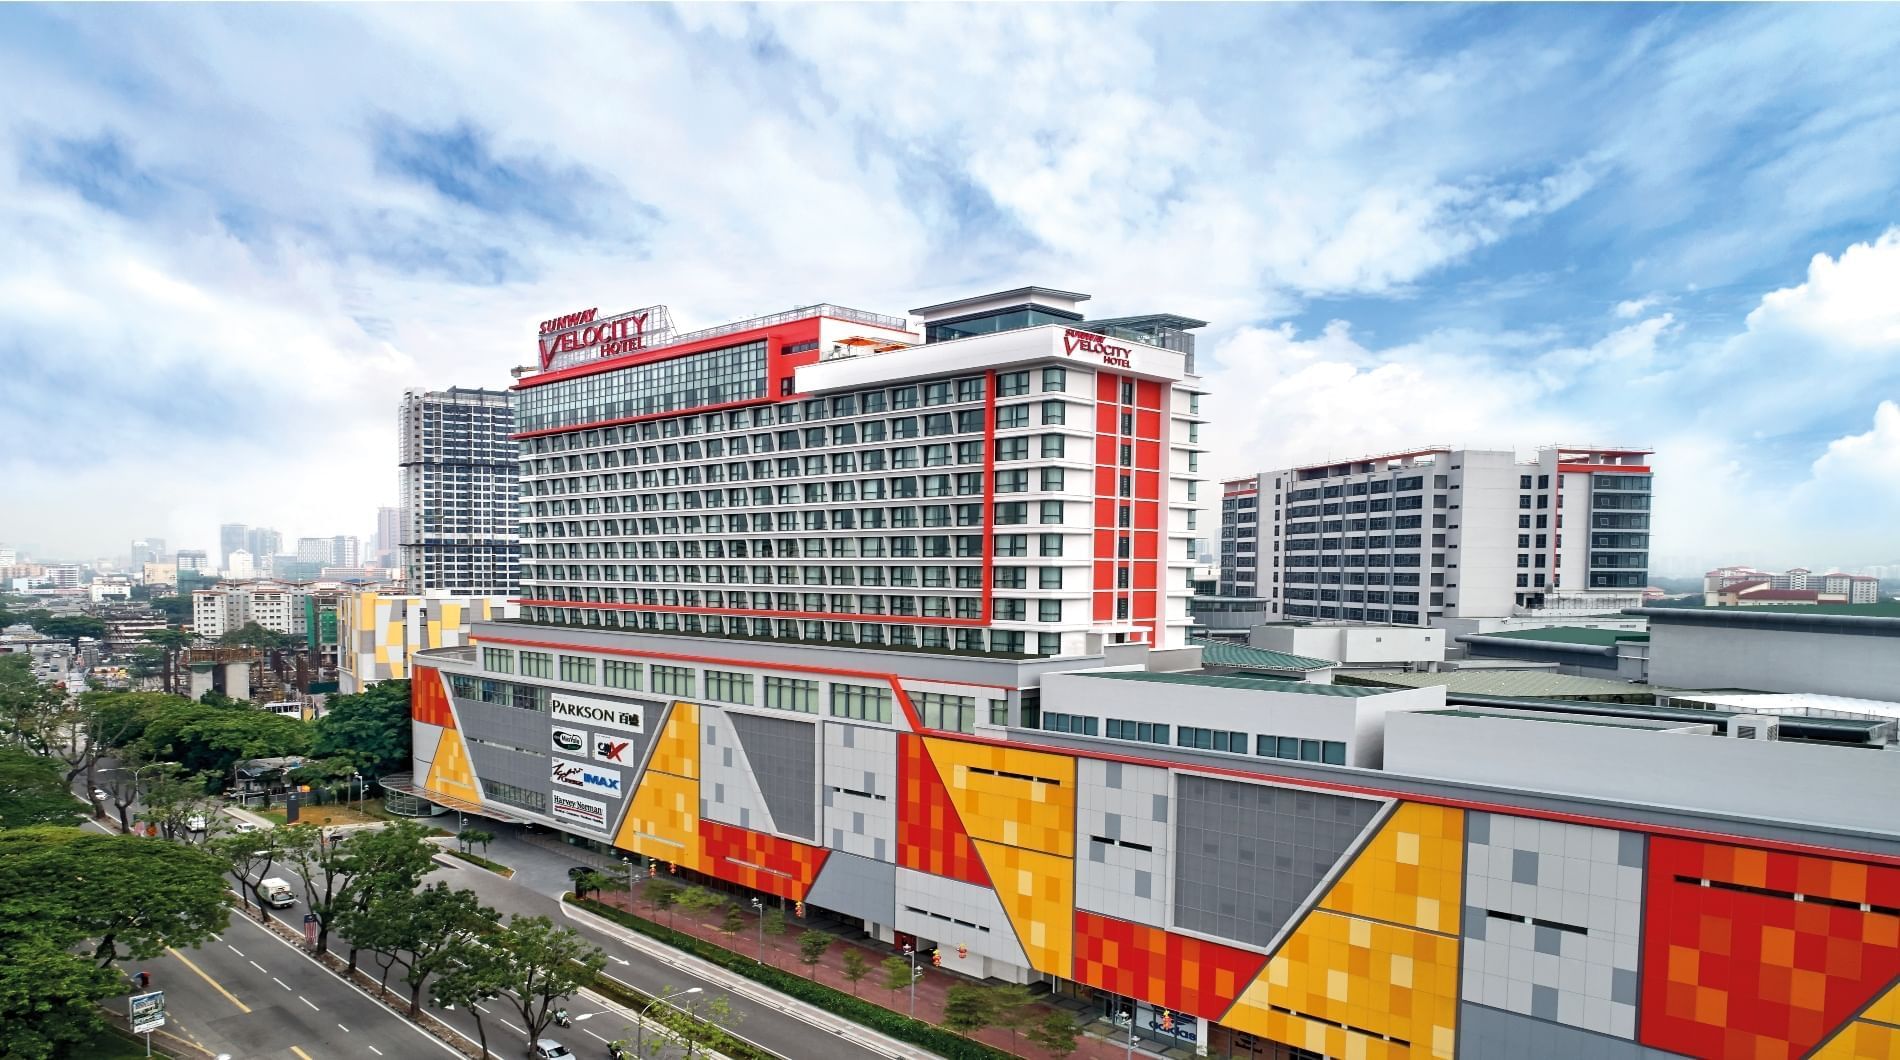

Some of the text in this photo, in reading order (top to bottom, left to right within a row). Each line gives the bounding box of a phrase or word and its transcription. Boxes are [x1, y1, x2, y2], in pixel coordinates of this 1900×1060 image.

[539, 307, 598, 334] SUNWAY
[538, 312, 649, 371] VELOCITY
[600, 337, 647, 357] HOTEL
[1063, 336, 1132, 359] VELOCITY
[1103, 356, 1131, 368] HOTEL
[552, 699, 615, 723] PARKSON
[583, 772, 619, 790] IMAX
[553, 794, 576, 808] Harvey
[576, 800, 603, 816] Norman
